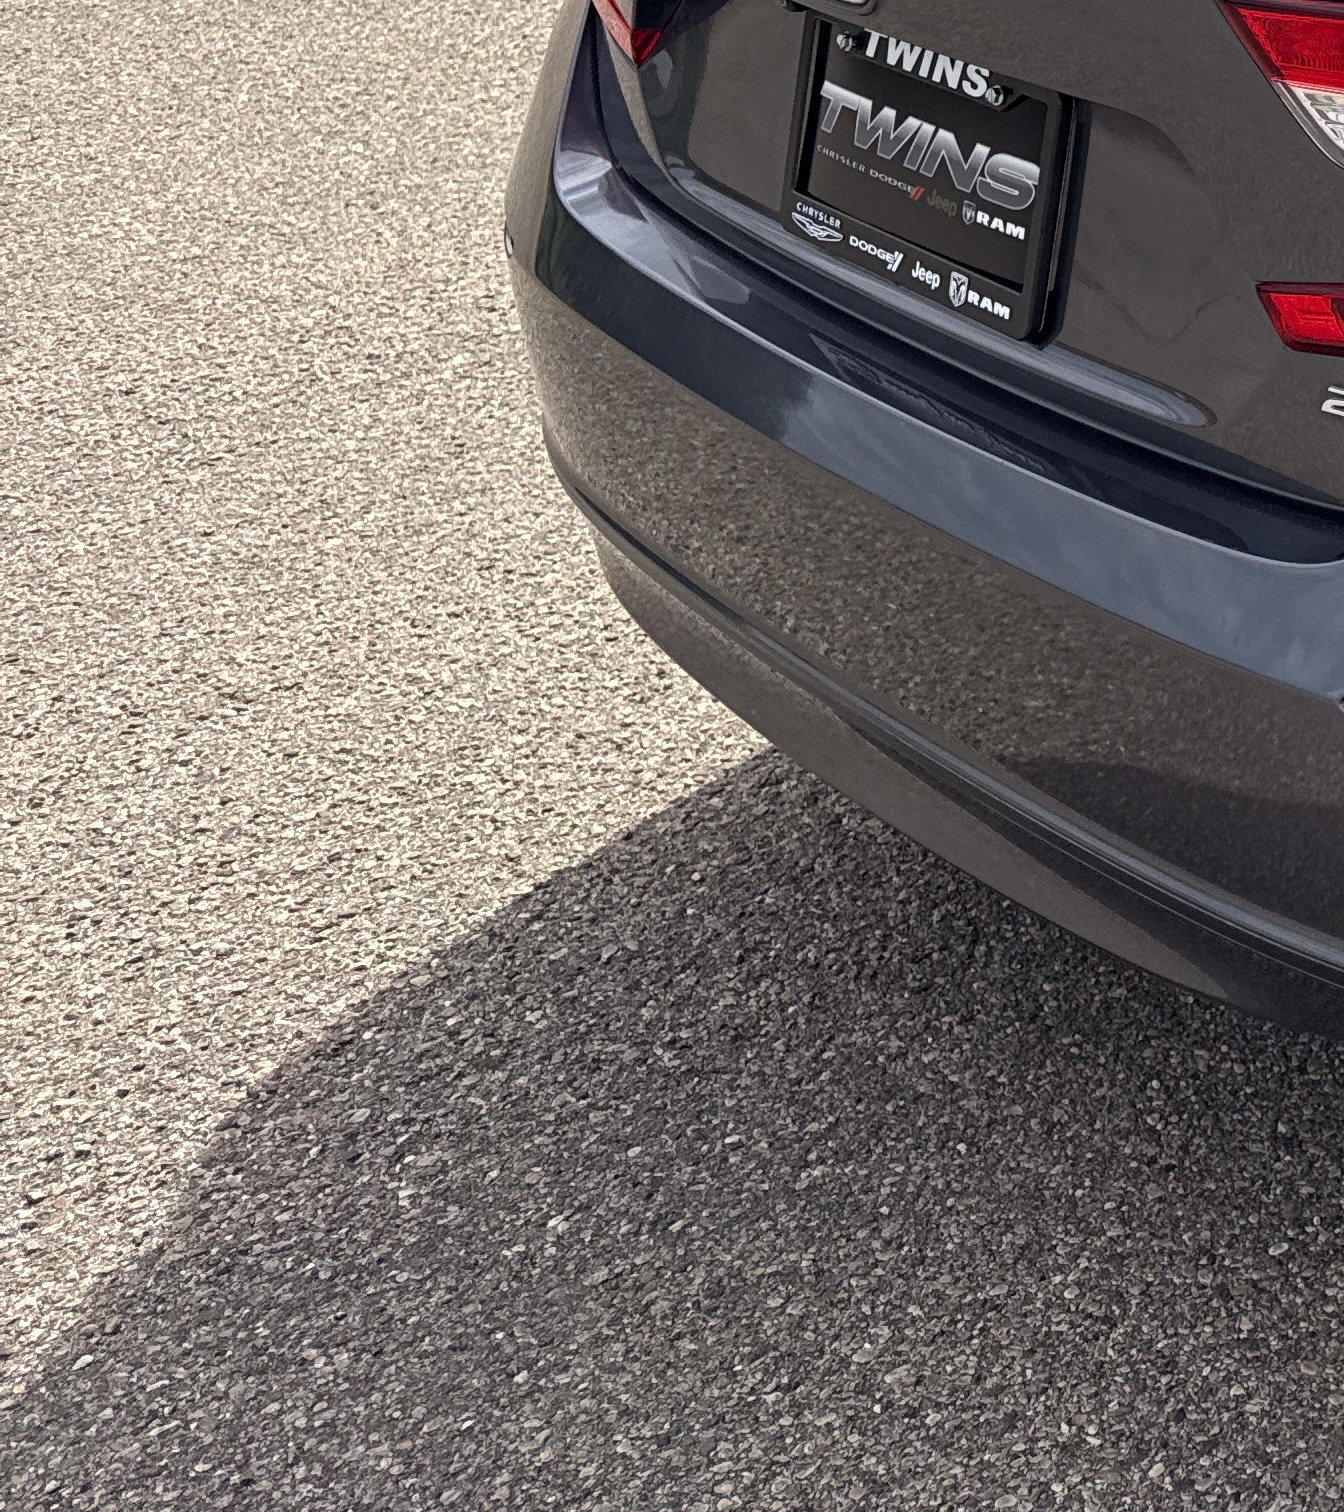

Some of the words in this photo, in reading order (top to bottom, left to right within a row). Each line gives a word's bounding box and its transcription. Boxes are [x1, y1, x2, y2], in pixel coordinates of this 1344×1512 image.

[864, 28, 990, 97] TWINS
[816, 144, 867, 173] CHRYSLER
[869, 168, 914, 194] DODGE
[927, 189, 958, 218] Jeep
[976, 210, 1026, 240] RAM
[820, 80, 1041, 210] TWINS
[797, 202, 841, 230] CHRYSLER
[849, 235, 897, 267] DODGE
[911, 261, 941, 291] Jeep
[967, 290, 1011, 320] RAM
